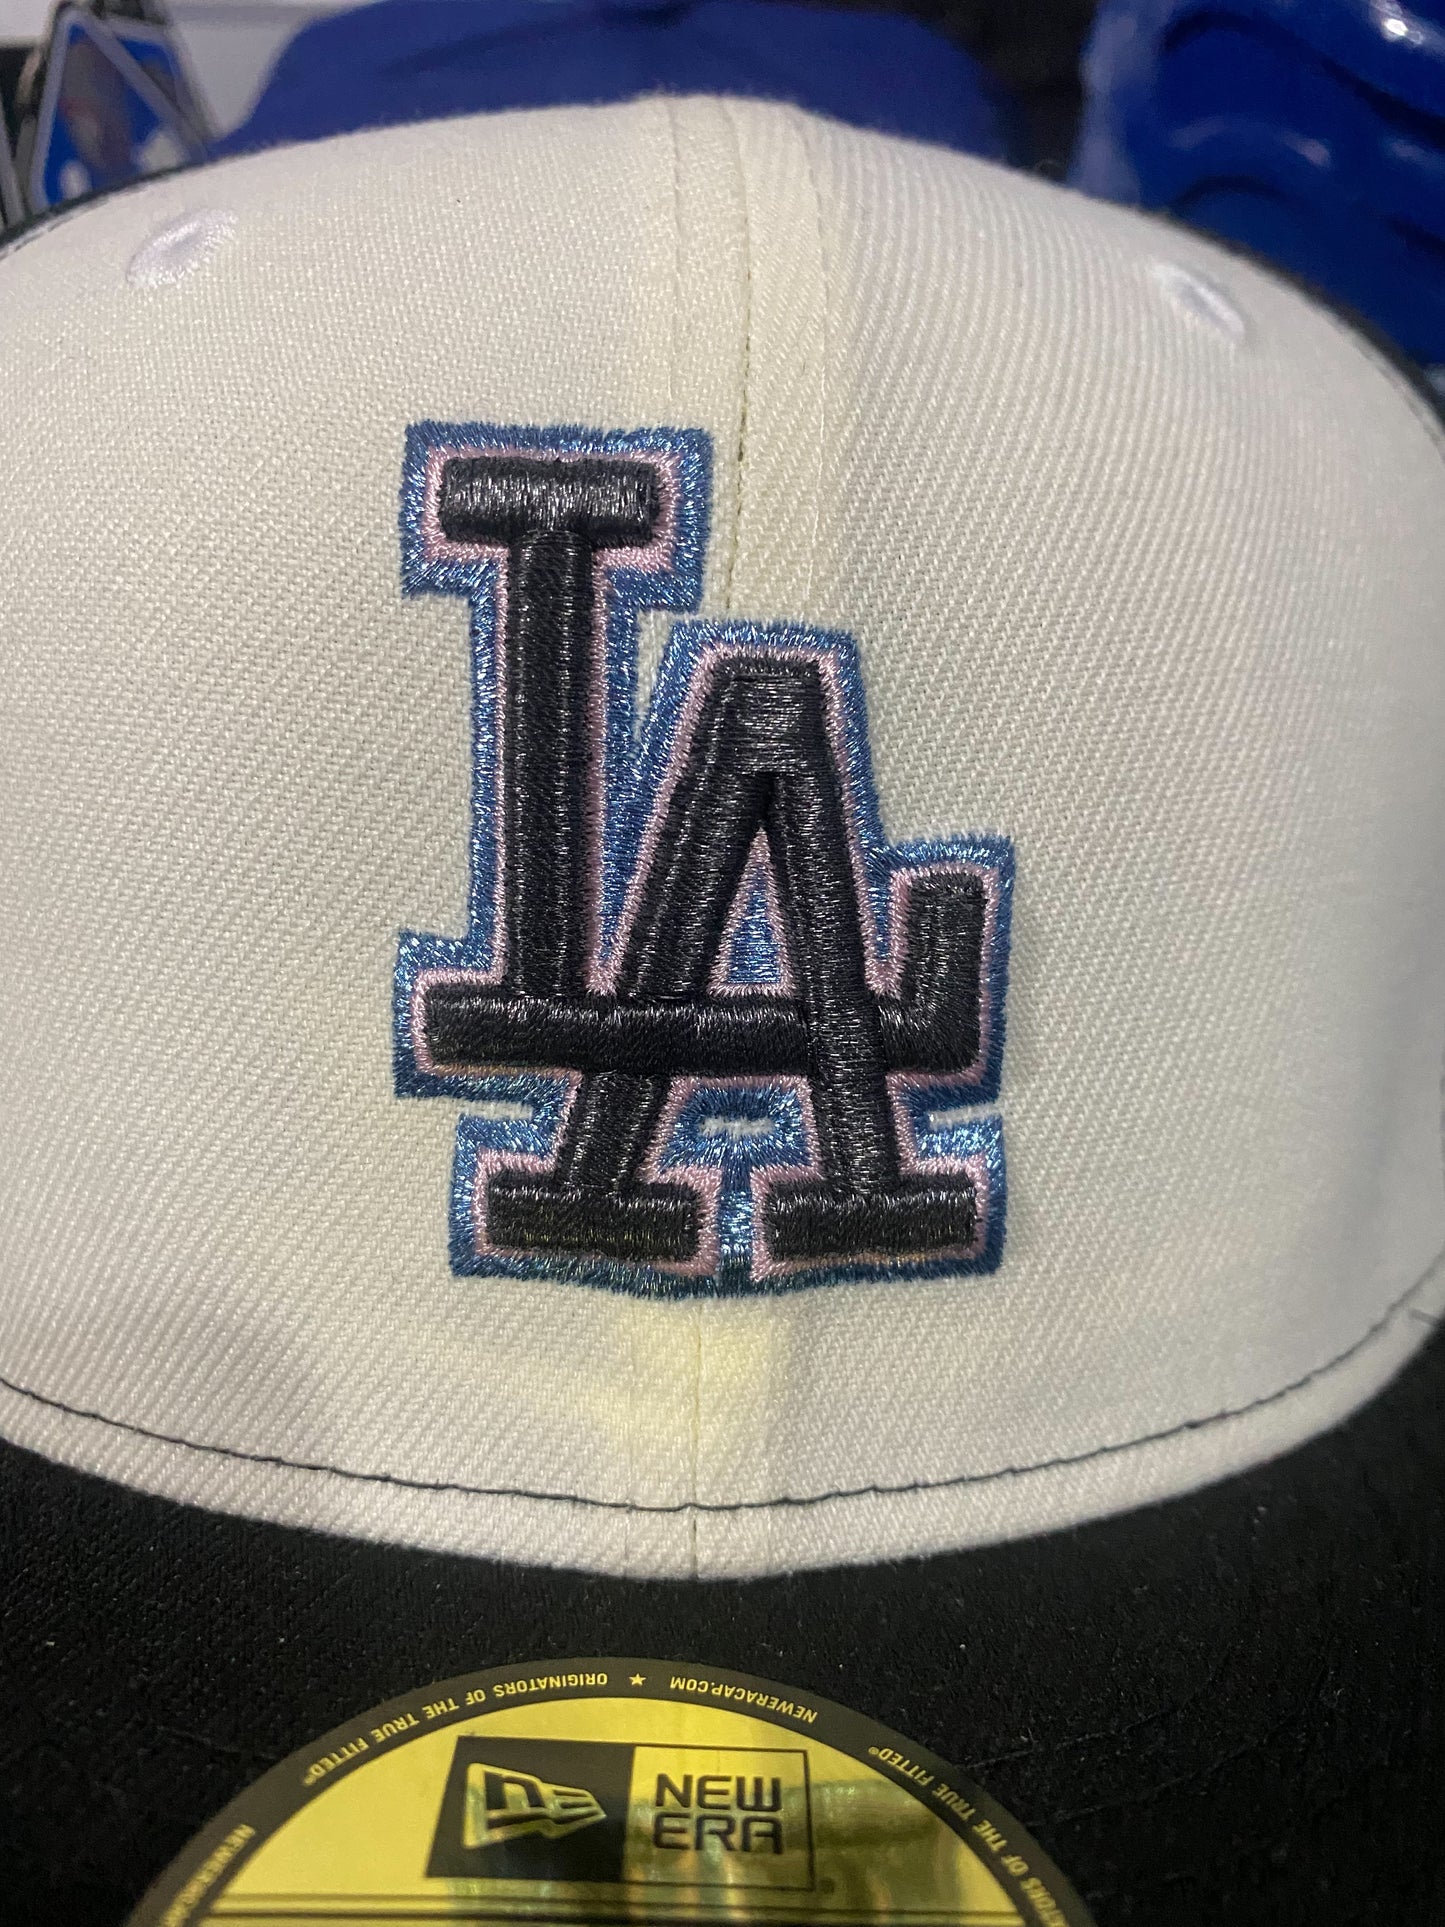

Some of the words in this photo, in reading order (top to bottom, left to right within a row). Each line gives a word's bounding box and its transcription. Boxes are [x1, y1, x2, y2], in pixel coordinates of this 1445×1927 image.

[394, 420, 1016, 1298] LA
[465, 1689, 486, 1706] OF
[494, 1672, 608, 1698] ORIGINATORS
[670, 1676, 818, 1724] NEWERACAP.COM
[422, 1697, 460, 1720] THE
[370, 1713, 420, 1744] TRUE
[654, 1773, 782, 1813] NEW
[931, 1783, 976, 1821] TRUE
[653, 1811, 784, 1855] ERA
[972, 1819, 1007, 1852] THE
[1001, 1854, 1029, 1877] OF
